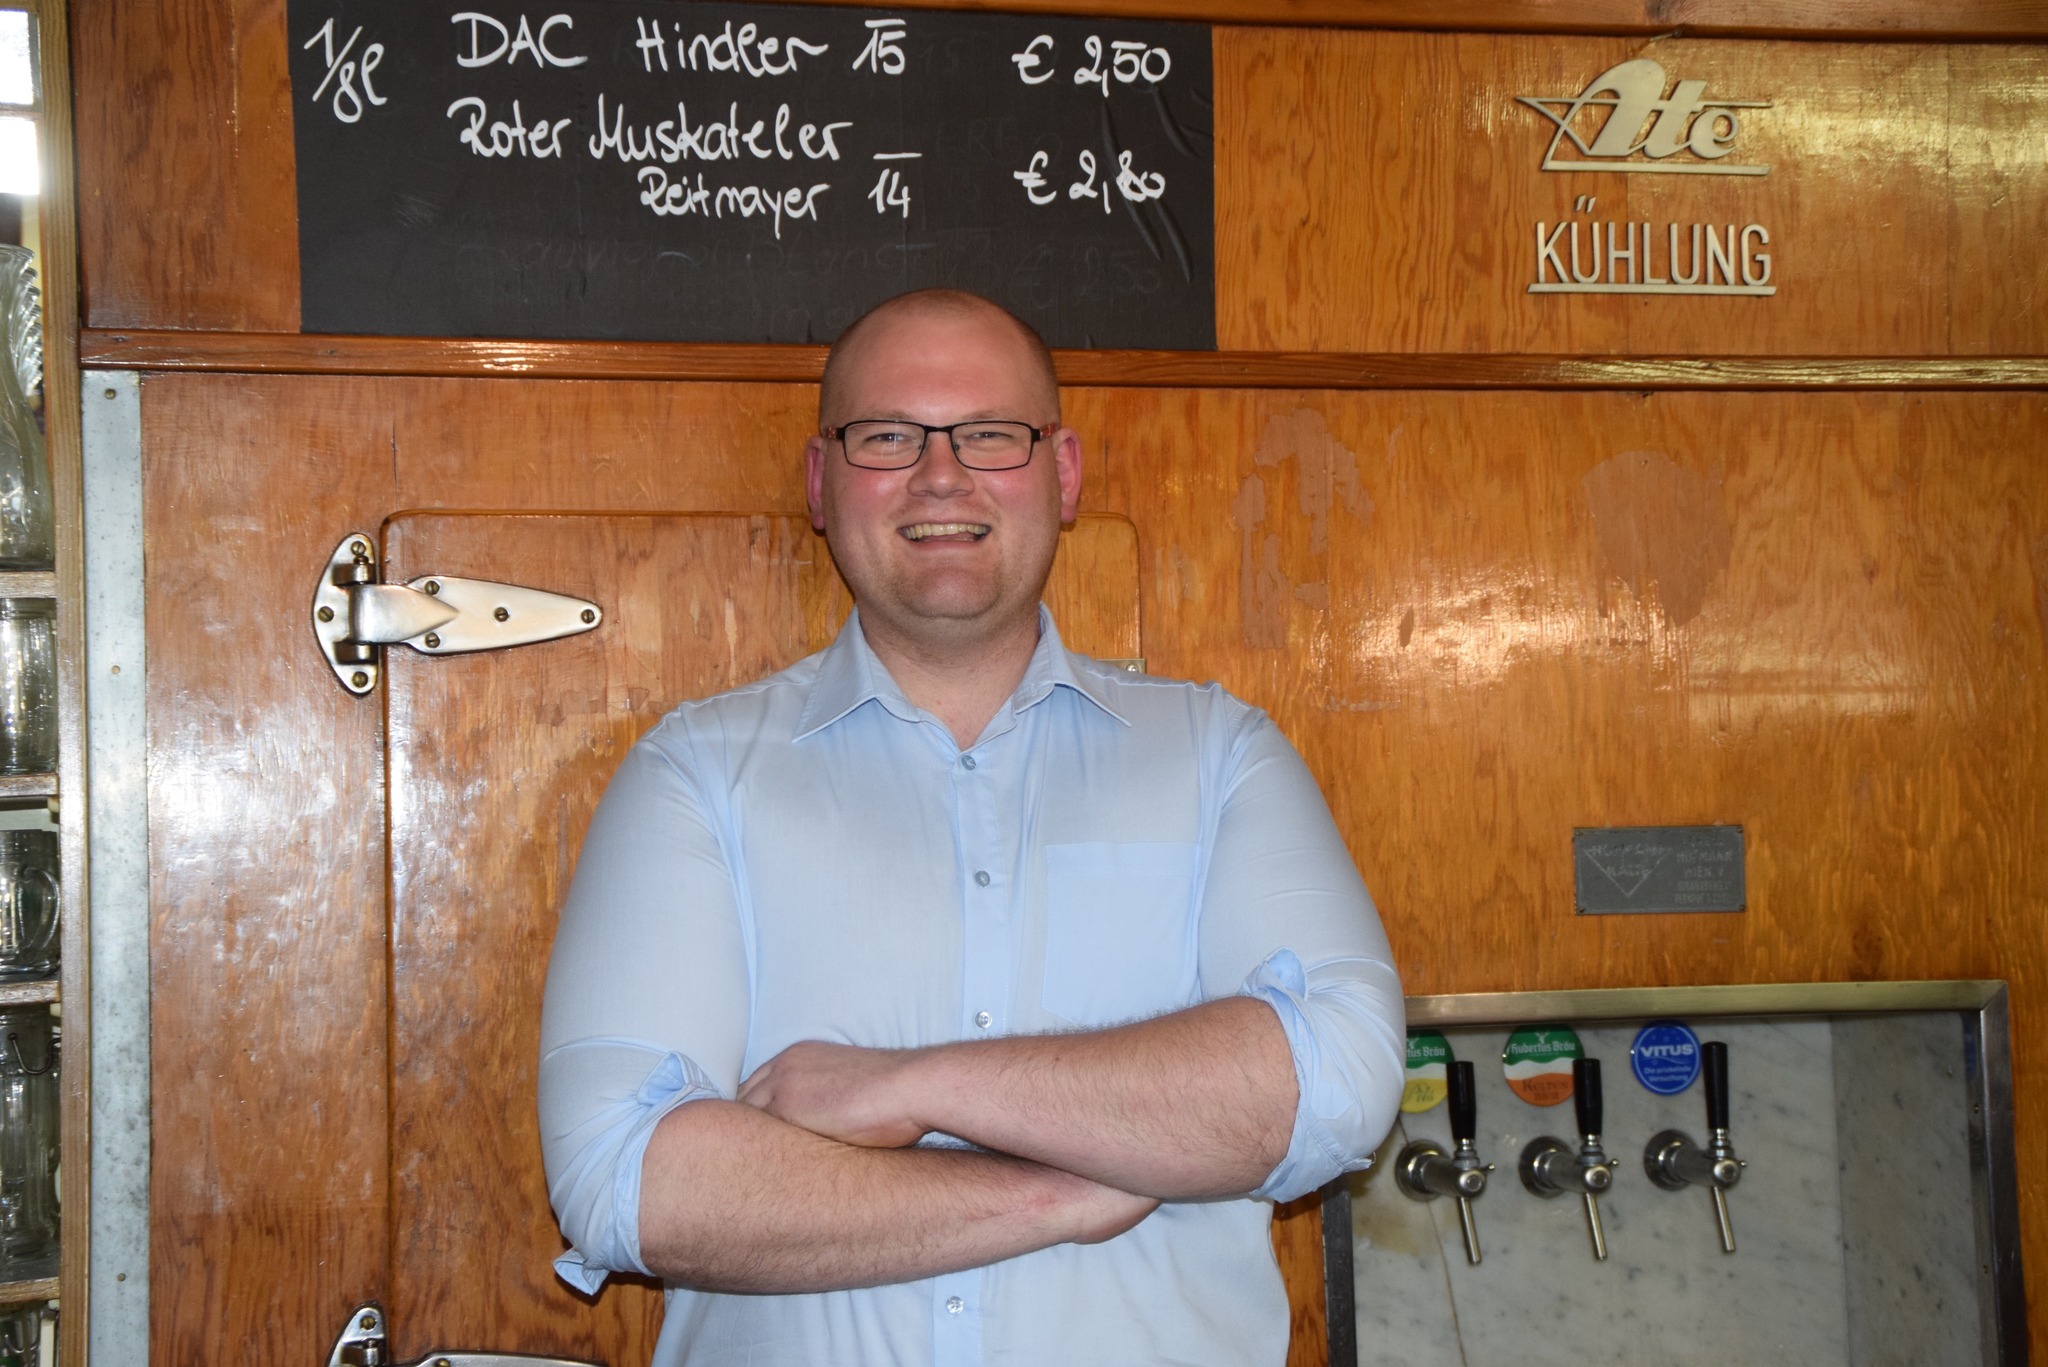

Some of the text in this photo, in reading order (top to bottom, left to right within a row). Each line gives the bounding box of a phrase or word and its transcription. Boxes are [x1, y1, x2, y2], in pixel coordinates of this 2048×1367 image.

[452, 13, 588, 68] DAC
[636, 17, 829, 77] Hindler
[853, 19, 906, 74] 15
[1012, 35, 1055, 84] €
[1074, 35, 1171, 98] 2,50
[447, 97, 571, 158] Roter
[868, 153, 922, 218] 14
[1014, 150, 1056, 204] €
[637, 166, 831, 239] Reitmayer
[1536, 194, 1772, 287] KÜHLUNG
[1422, 1046, 1446, 1057] Bräu
[1511, 1040, 1576, 1055] Hubertus Bräu
[1641, 1044, 1694, 1057] VITUS
